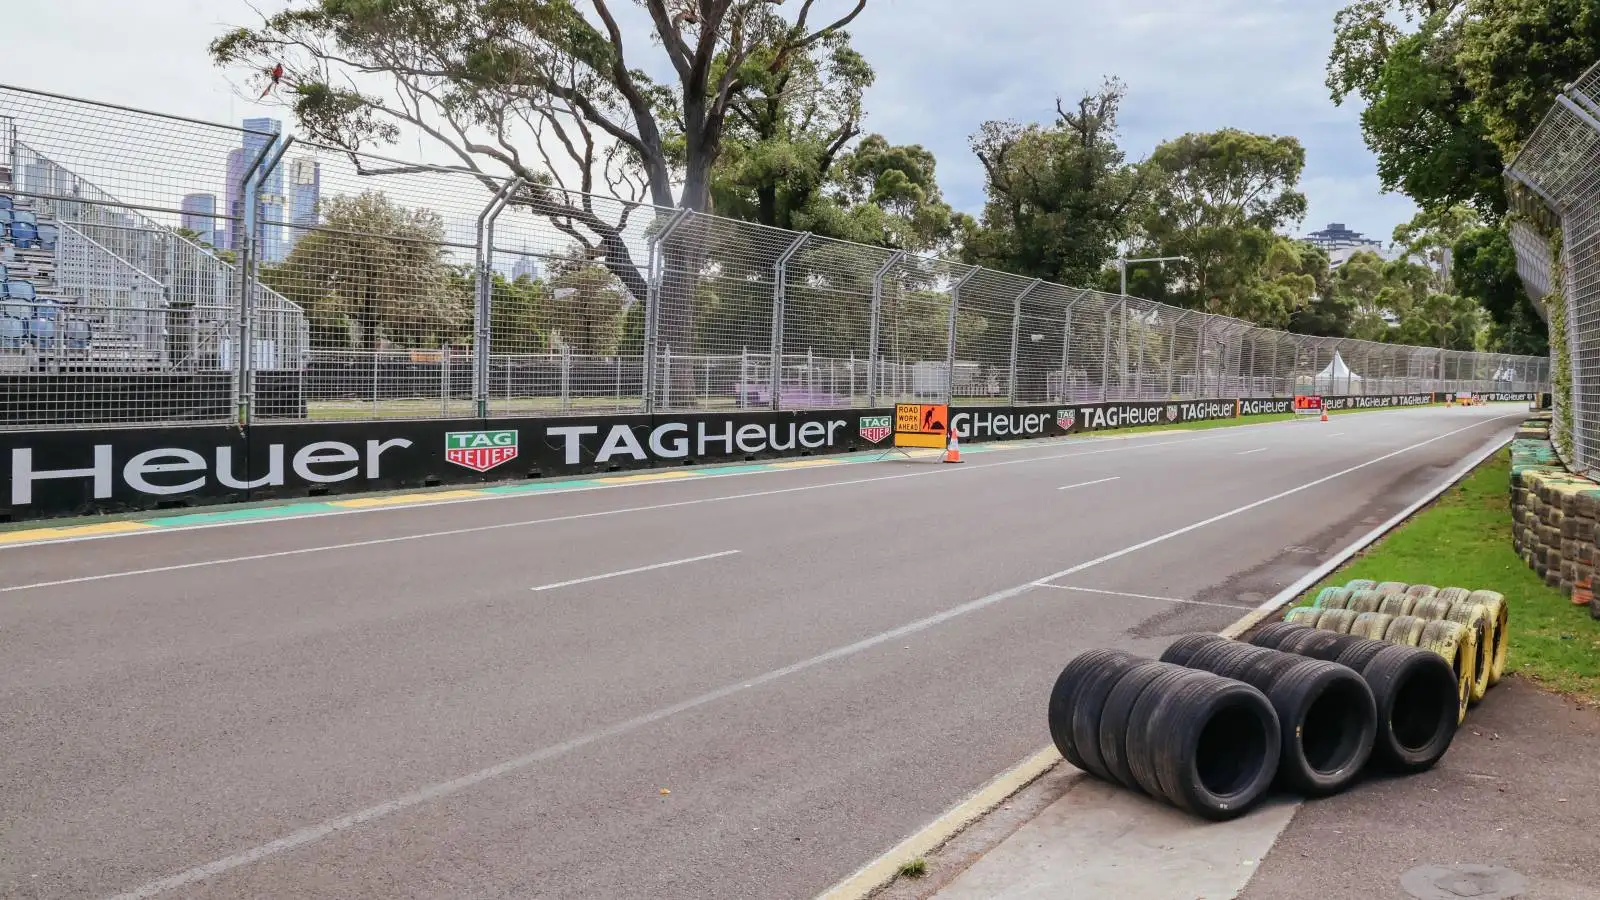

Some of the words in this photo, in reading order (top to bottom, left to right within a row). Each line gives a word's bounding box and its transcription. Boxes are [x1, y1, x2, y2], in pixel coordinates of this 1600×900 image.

[1355, 397, 1390, 407] TAGHeuer
[1399, 395, 1431, 405] TAGHeuer
[1080, 406, 1163, 428] TAGHeuer
[1181, 403, 1234, 420] TAGHeuer
[863, 418, 888, 427] TAG
[452, 433, 511, 447] TAG
[547, 419, 847, 464] TAGHeuer
[862, 428, 889, 441] HEUER
[450, 448, 513, 468] HEUER
[12, 438, 413, 504] Heuer
